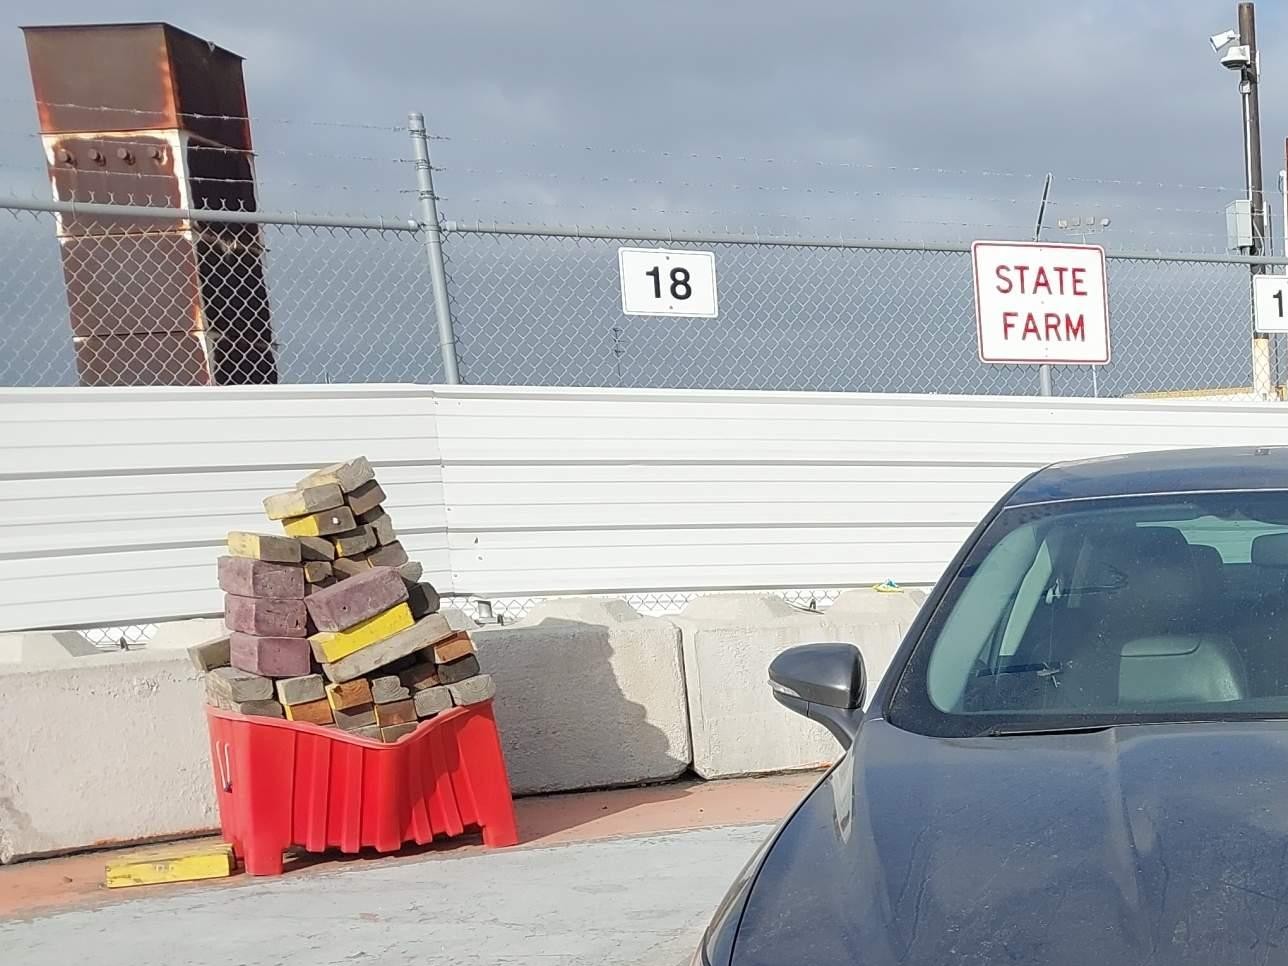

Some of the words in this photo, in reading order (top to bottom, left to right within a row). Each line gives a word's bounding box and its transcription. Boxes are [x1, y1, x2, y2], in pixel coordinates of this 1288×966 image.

[645, 266, 692, 300] 18
[996, 265, 1088, 296] STATE
[1003, 312, 1086, 342] FARM
